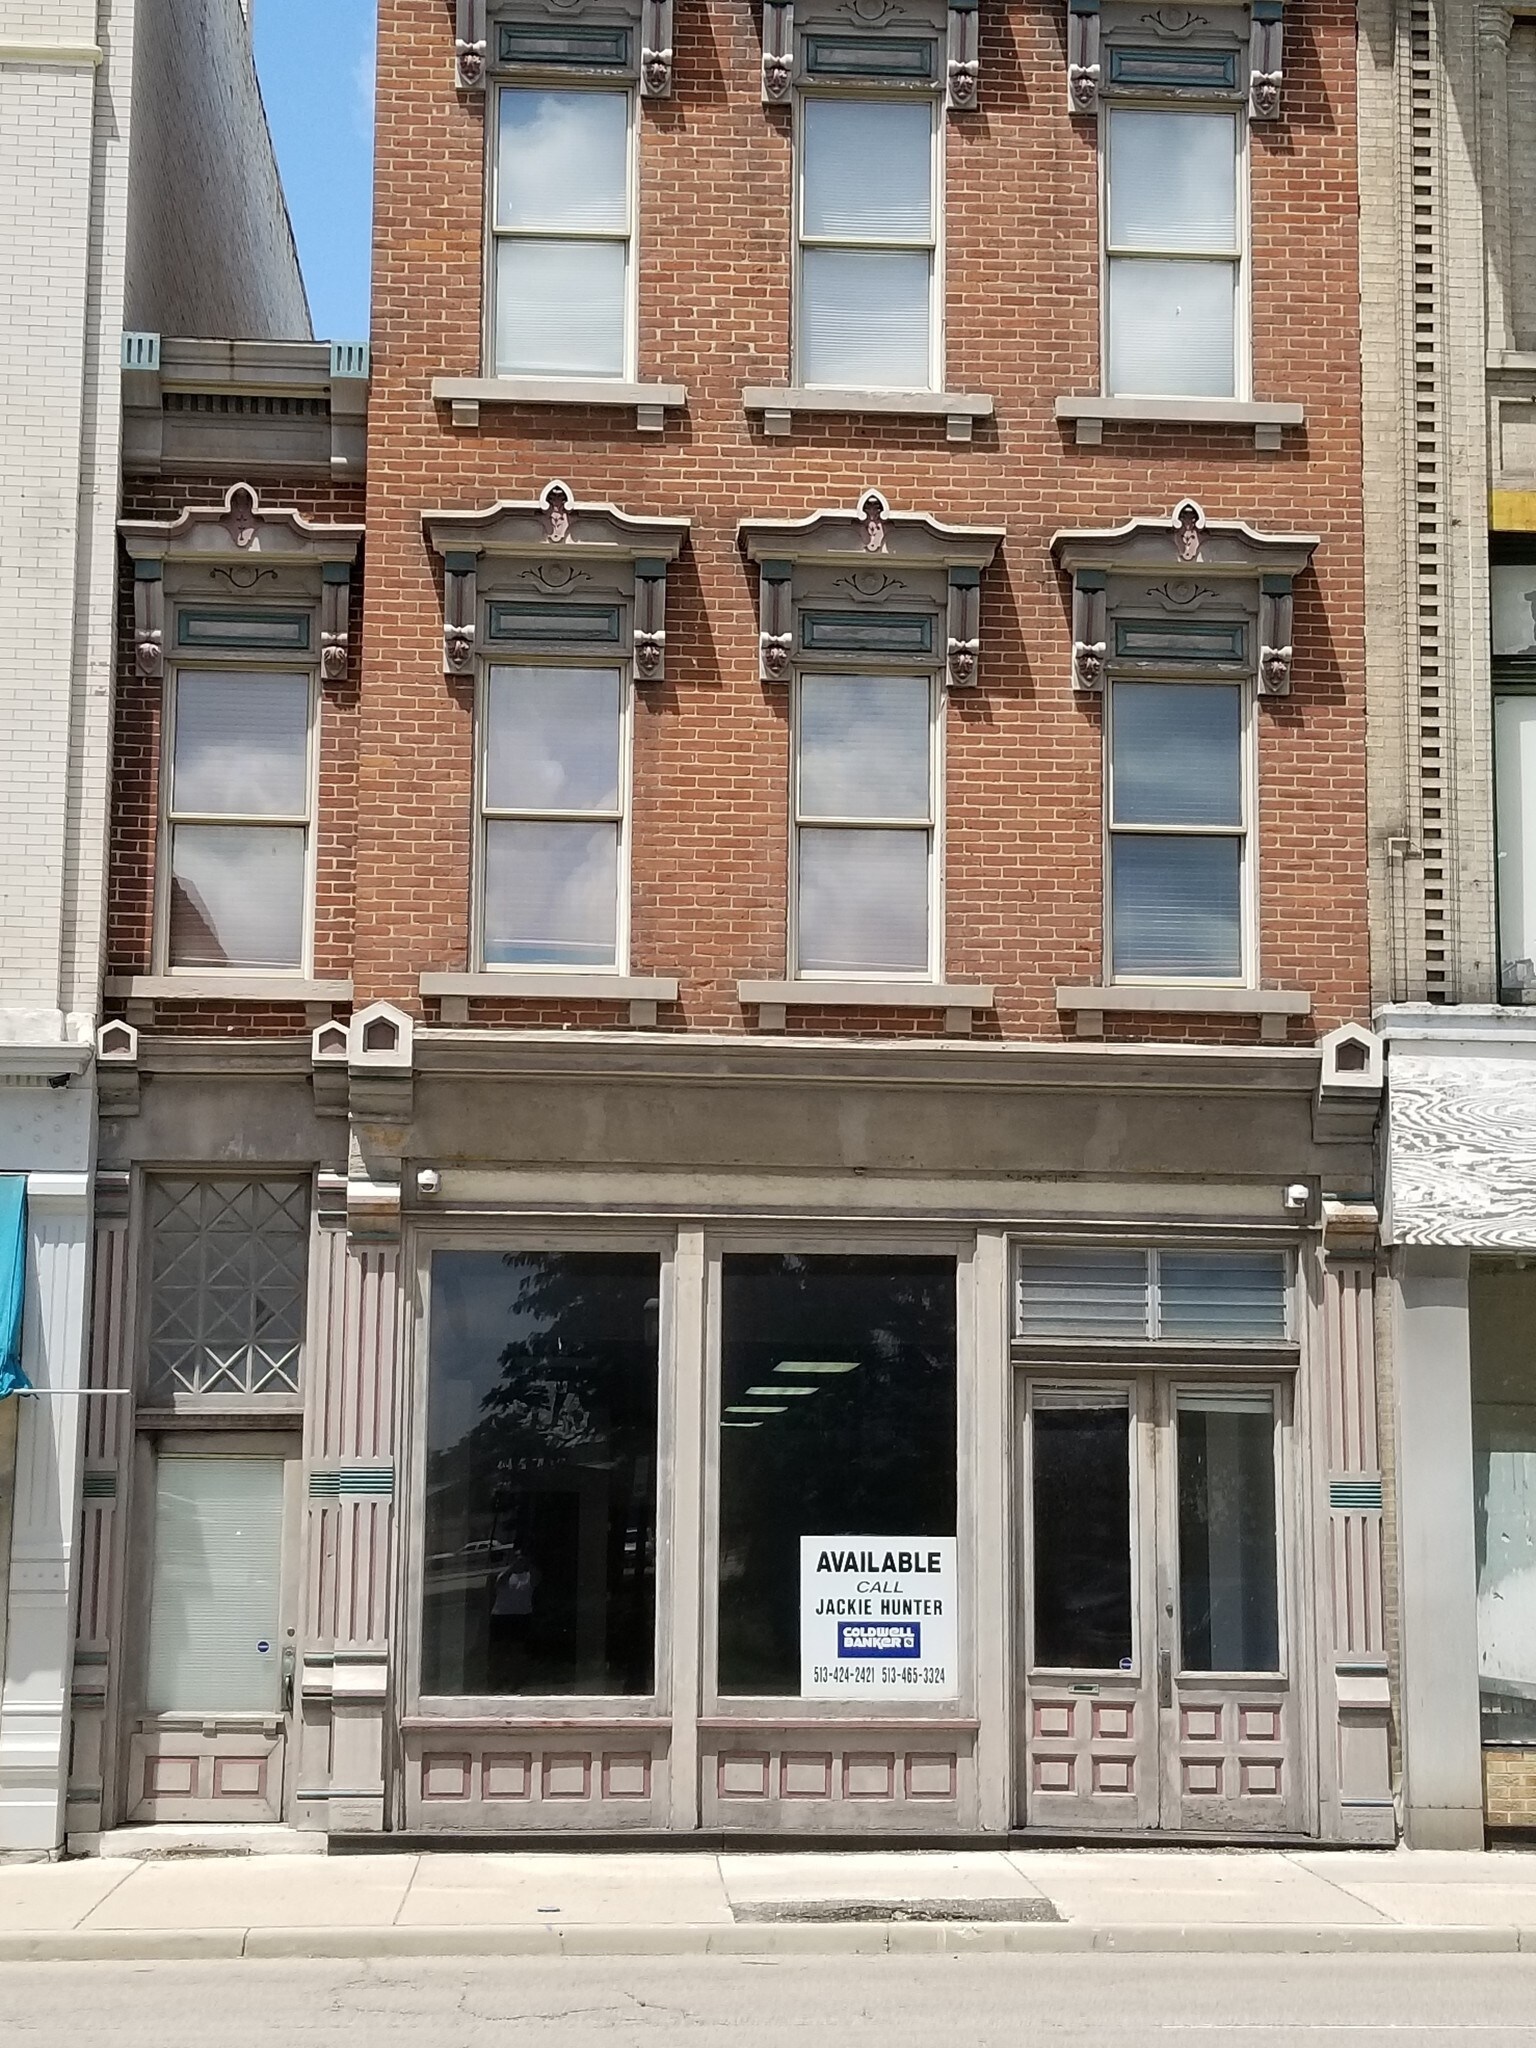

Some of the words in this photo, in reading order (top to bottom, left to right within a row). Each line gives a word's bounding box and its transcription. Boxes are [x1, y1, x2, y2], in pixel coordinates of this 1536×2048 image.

[816, 1551, 941, 1573] AVAILABLE
[856, 1580, 904, 1594] CALL
[815, 1599, 873, 1615] JACKIE
[880, 1599, 943, 1616] HUNTER
[814, 1666, 875, 1683] 513-424-2421
[881, 1667, 945, 1684] 513-465-3324
